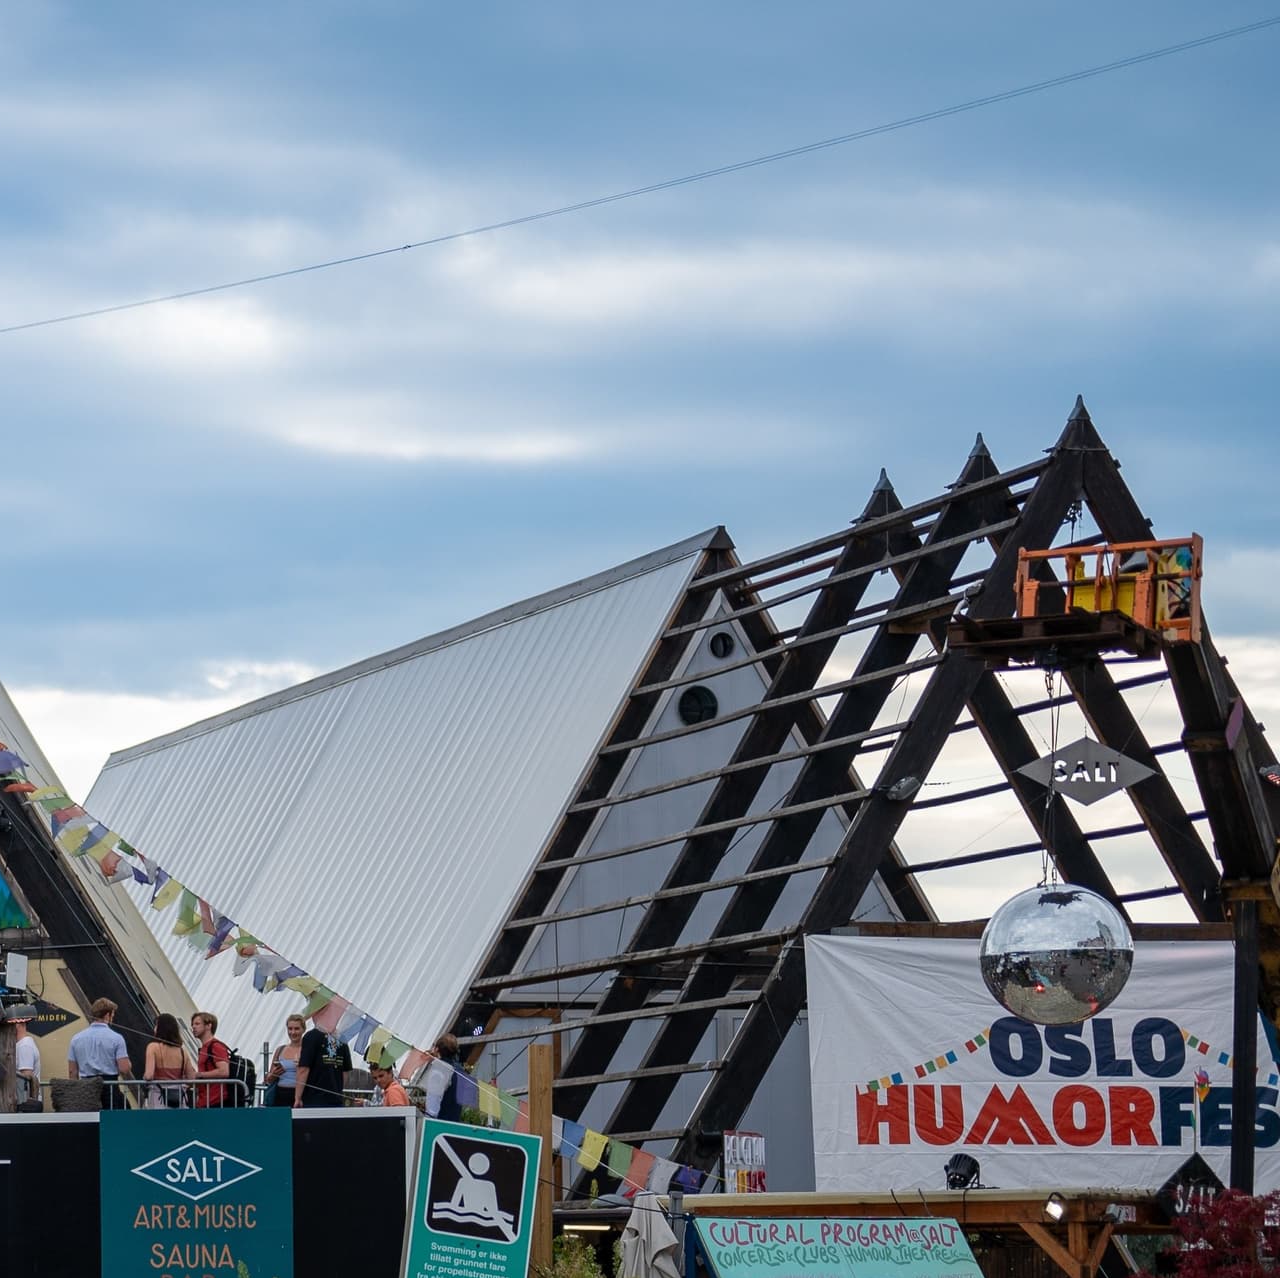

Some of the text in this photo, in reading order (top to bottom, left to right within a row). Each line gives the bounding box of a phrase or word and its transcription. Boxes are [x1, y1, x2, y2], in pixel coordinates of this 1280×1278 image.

[1054, 760, 1120, 782] SALT
[989, 1015, 1186, 1078] OSLO
[165, 1156, 225, 1183] SALT
[709, 1220, 815, 1247] CULTURAL
[150, 1244, 235, 1269] SAUNA
[424, 1262, 436, 1271] for
[430, 1253, 507, 1272] tillatt grunnet fare
[489, 1251, 508, 1262] ikke
